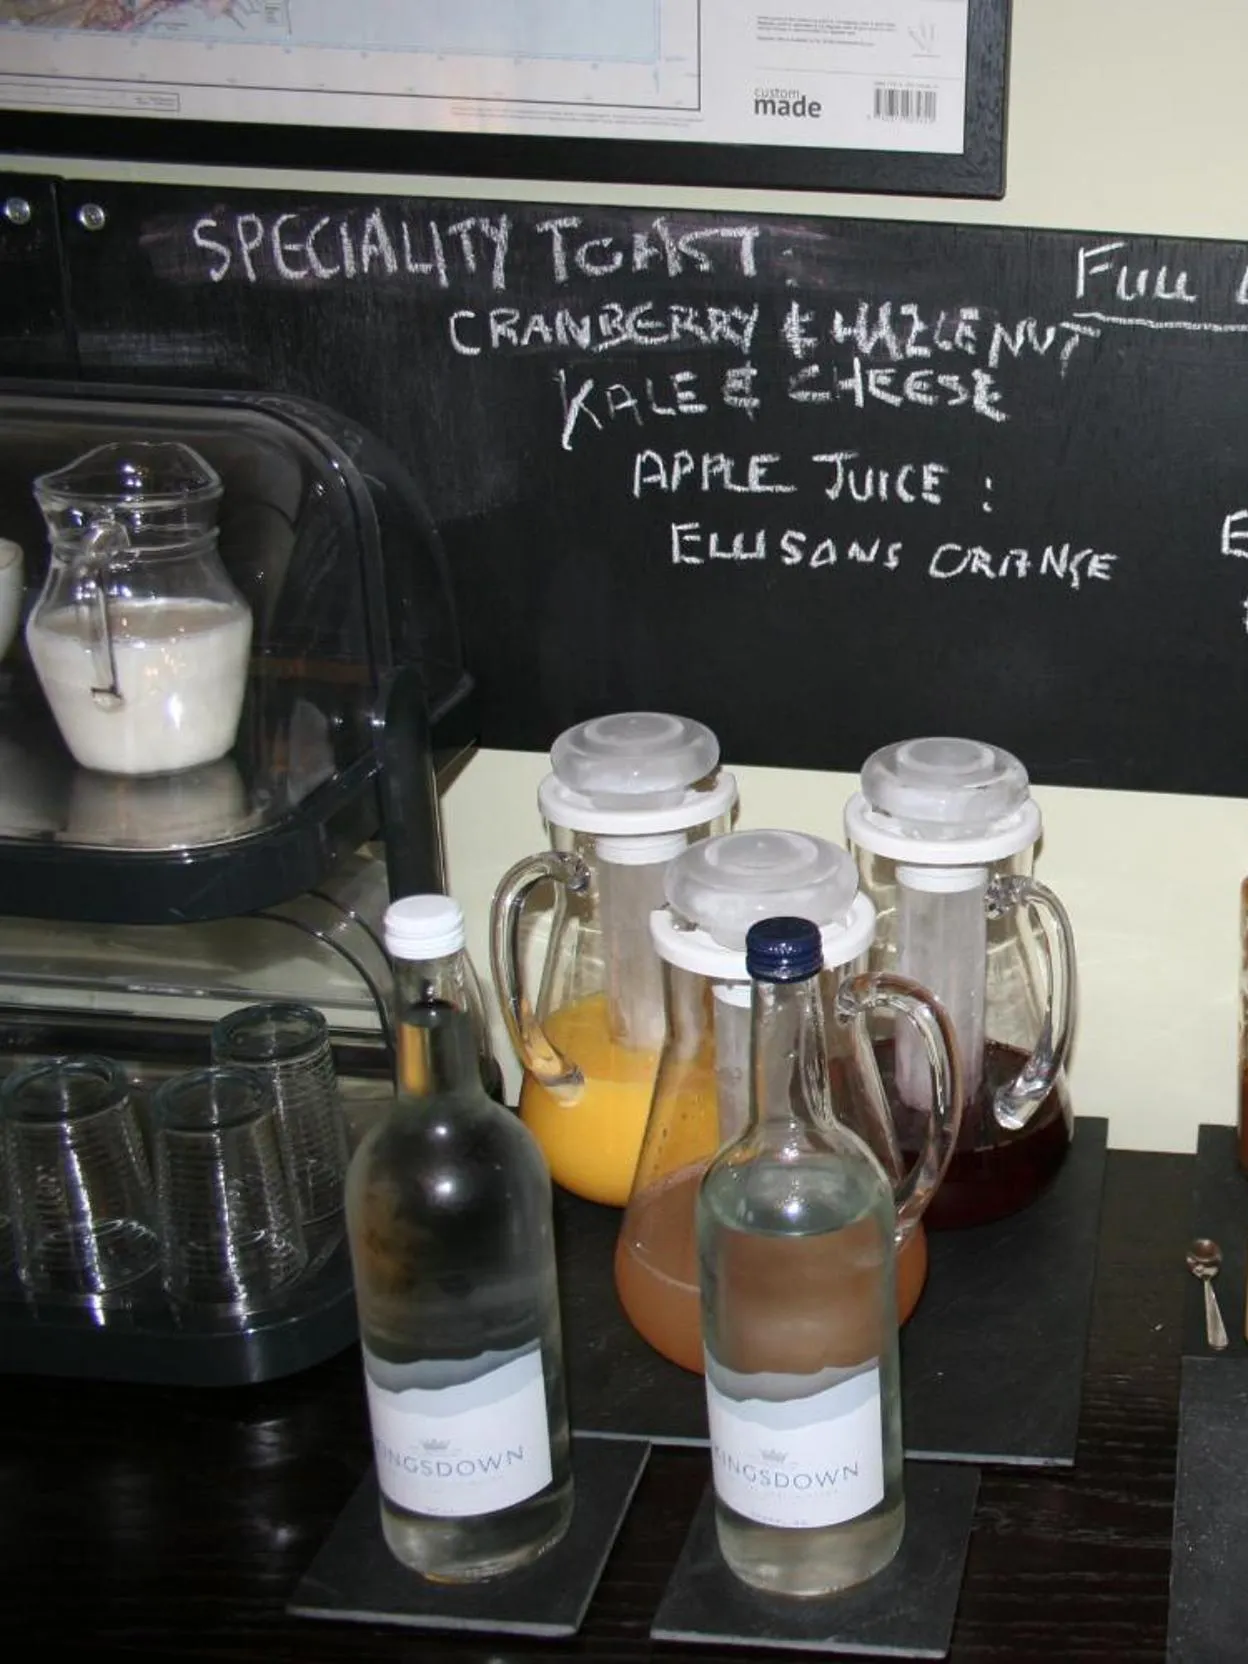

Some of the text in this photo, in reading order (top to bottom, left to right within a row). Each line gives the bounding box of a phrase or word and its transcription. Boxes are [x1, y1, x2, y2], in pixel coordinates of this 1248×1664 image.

[754, 87, 800, 99] custom
[754, 96, 822, 118] made
[193, 206, 512, 290] SPECIALITY
[1075, 242, 1197, 302] FULL
[448, 301, 759, 355] CRANBERRY
[553, 369, 706, 450] KALE
[789, 357, 1010, 421] CHEESE
[633, 450, 797, 498] APPLE
[929, 542, 1120, 590] ORANGE
